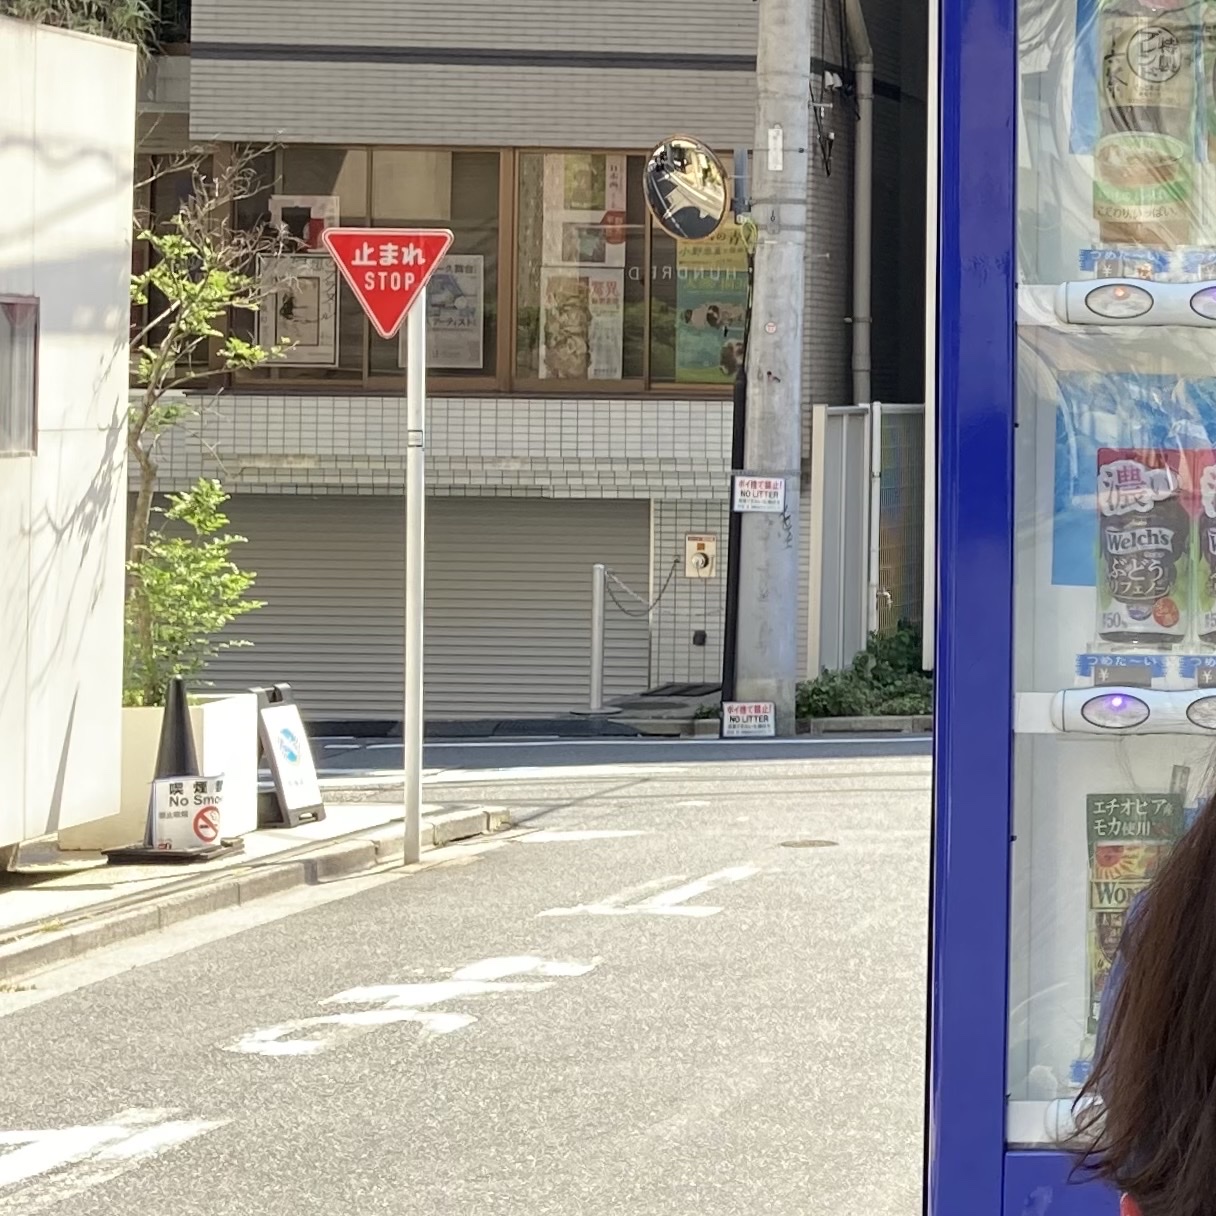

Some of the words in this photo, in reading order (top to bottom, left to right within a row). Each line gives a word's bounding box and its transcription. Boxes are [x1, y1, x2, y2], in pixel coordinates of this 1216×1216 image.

[351, 242, 426, 266] 止まれ
[364, 272, 416, 291] STOP
[1108, 529, 1169, 551] Welch's
[1109, 559, 1163, 581] ぶどう
[729, 715, 740, 723] NO
[742, 715, 769, 723] LITTER
[169, 796, 189, 807] No
[1093, 819, 1151, 837] モカ使用
